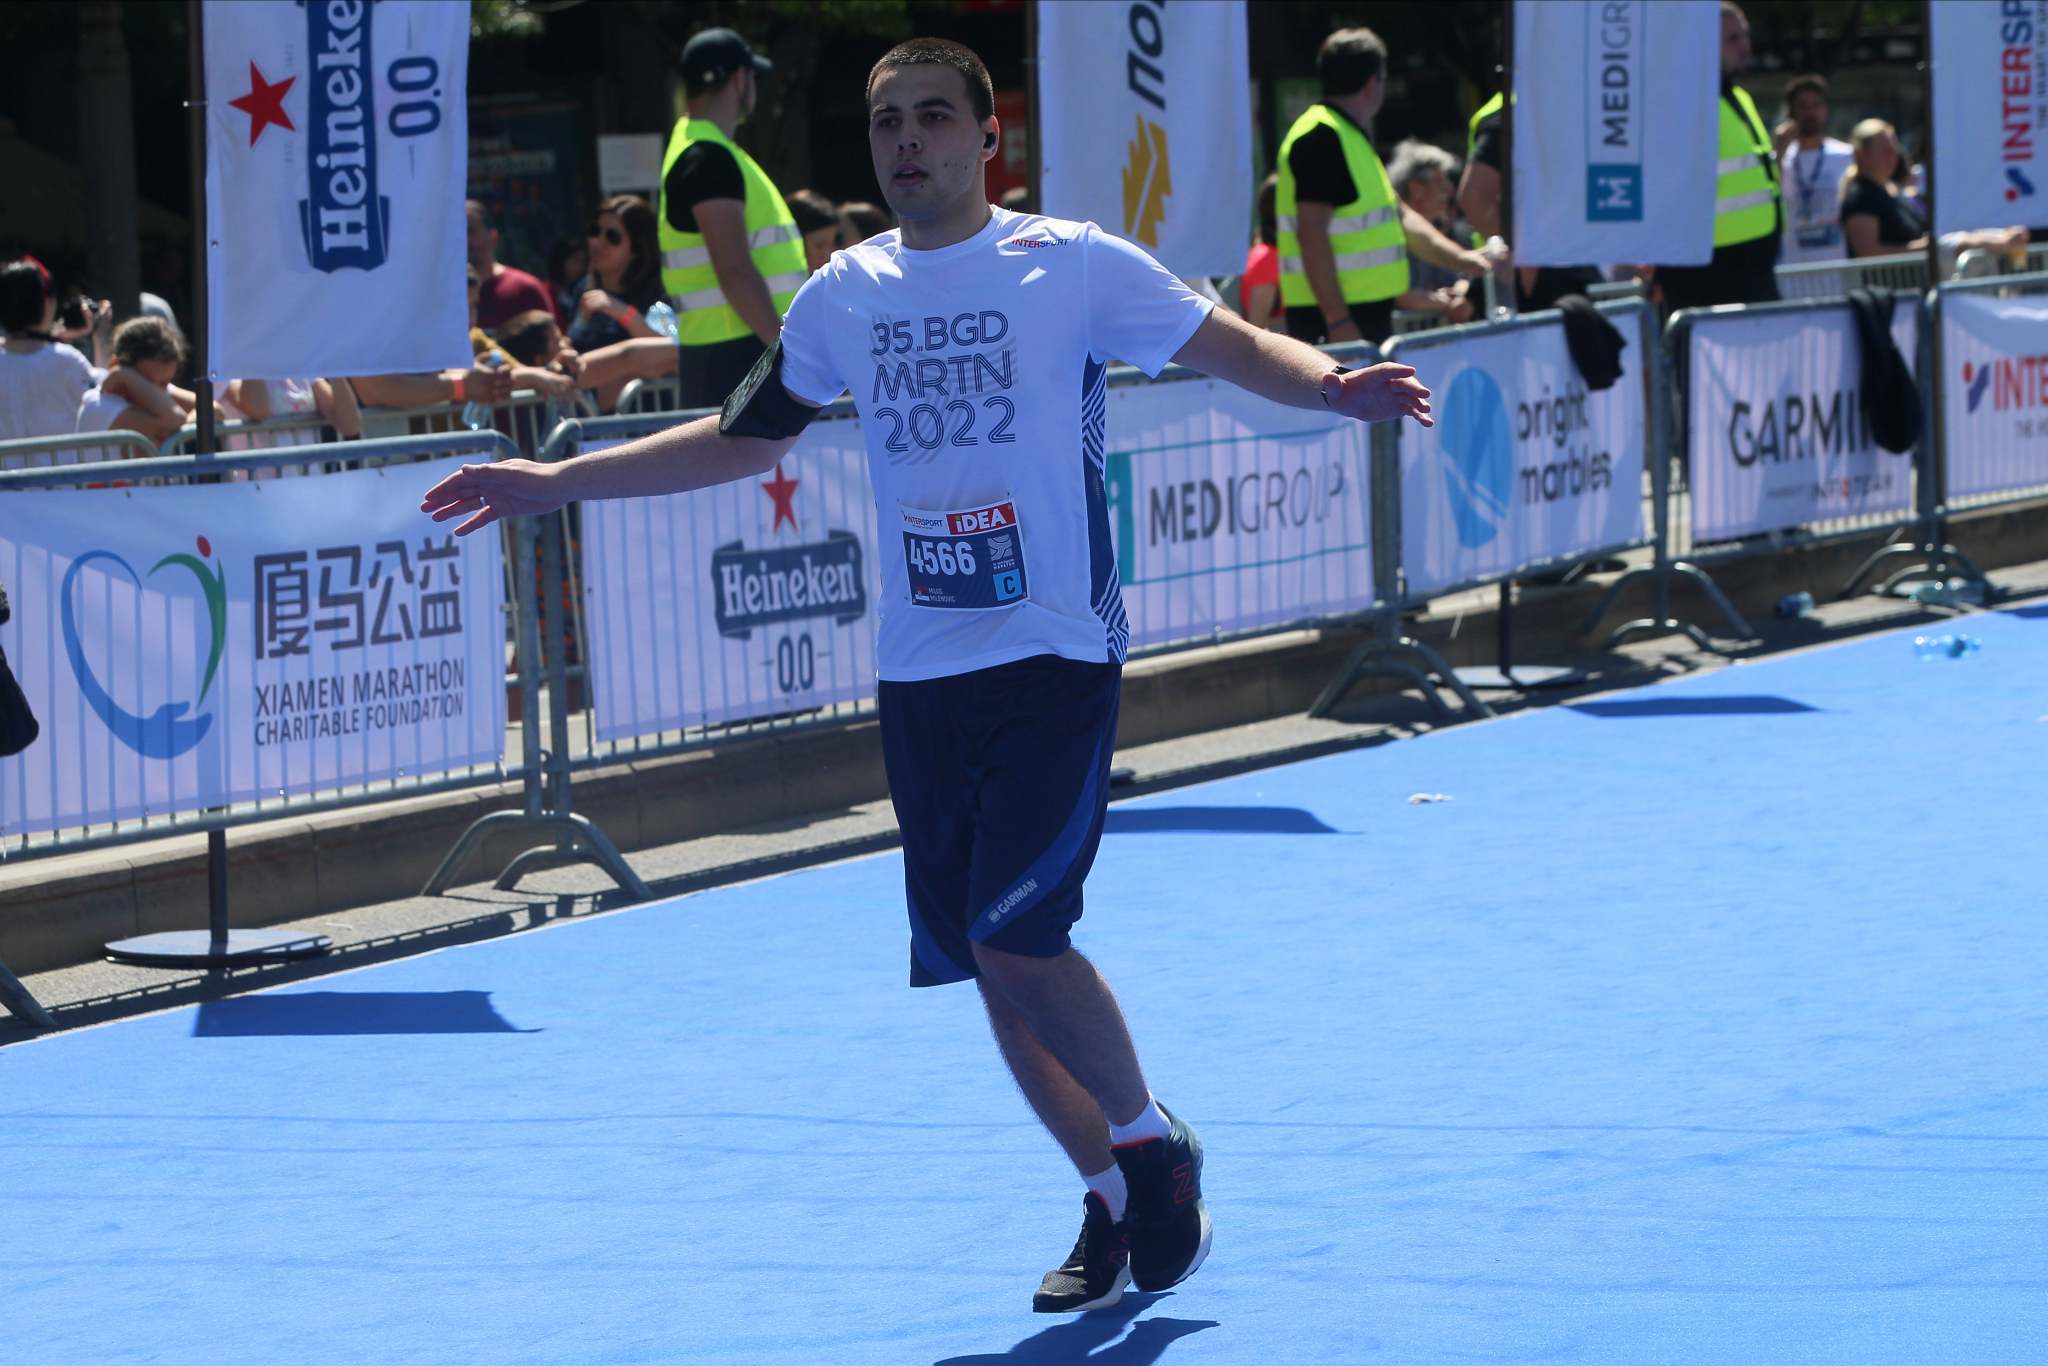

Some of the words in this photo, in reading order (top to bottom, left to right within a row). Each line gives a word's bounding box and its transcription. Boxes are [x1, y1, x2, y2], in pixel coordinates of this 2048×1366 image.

[1127, 0, 1167, 110] ПО
[386, 56, 441, 138] 0.0
[1012, 238, 1070, 249] INTERSPORT
[872, 350, 1013, 404] MRTN
[874, 396, 1016, 453] 2022
[1150, 462, 1344, 547] MEDIGROUP
[1519, 444, 1611, 506] marbles
[907, 515, 944, 527] INTERSPORT
[720, 554, 858, 618] Heineken
[910, 538, 977, 576] 4566
[253, 534, 463, 660] 厦马公益
[255, 676, 345, 717] XIAMEN
[353, 658, 465, 711] MARATHON
[777, 633, 815, 693] 0.0
[254, 706, 360, 747] CHARITABLE
[366, 691, 464, 731] FOUNDATION
[998, 878, 1038, 914] GARMAN
